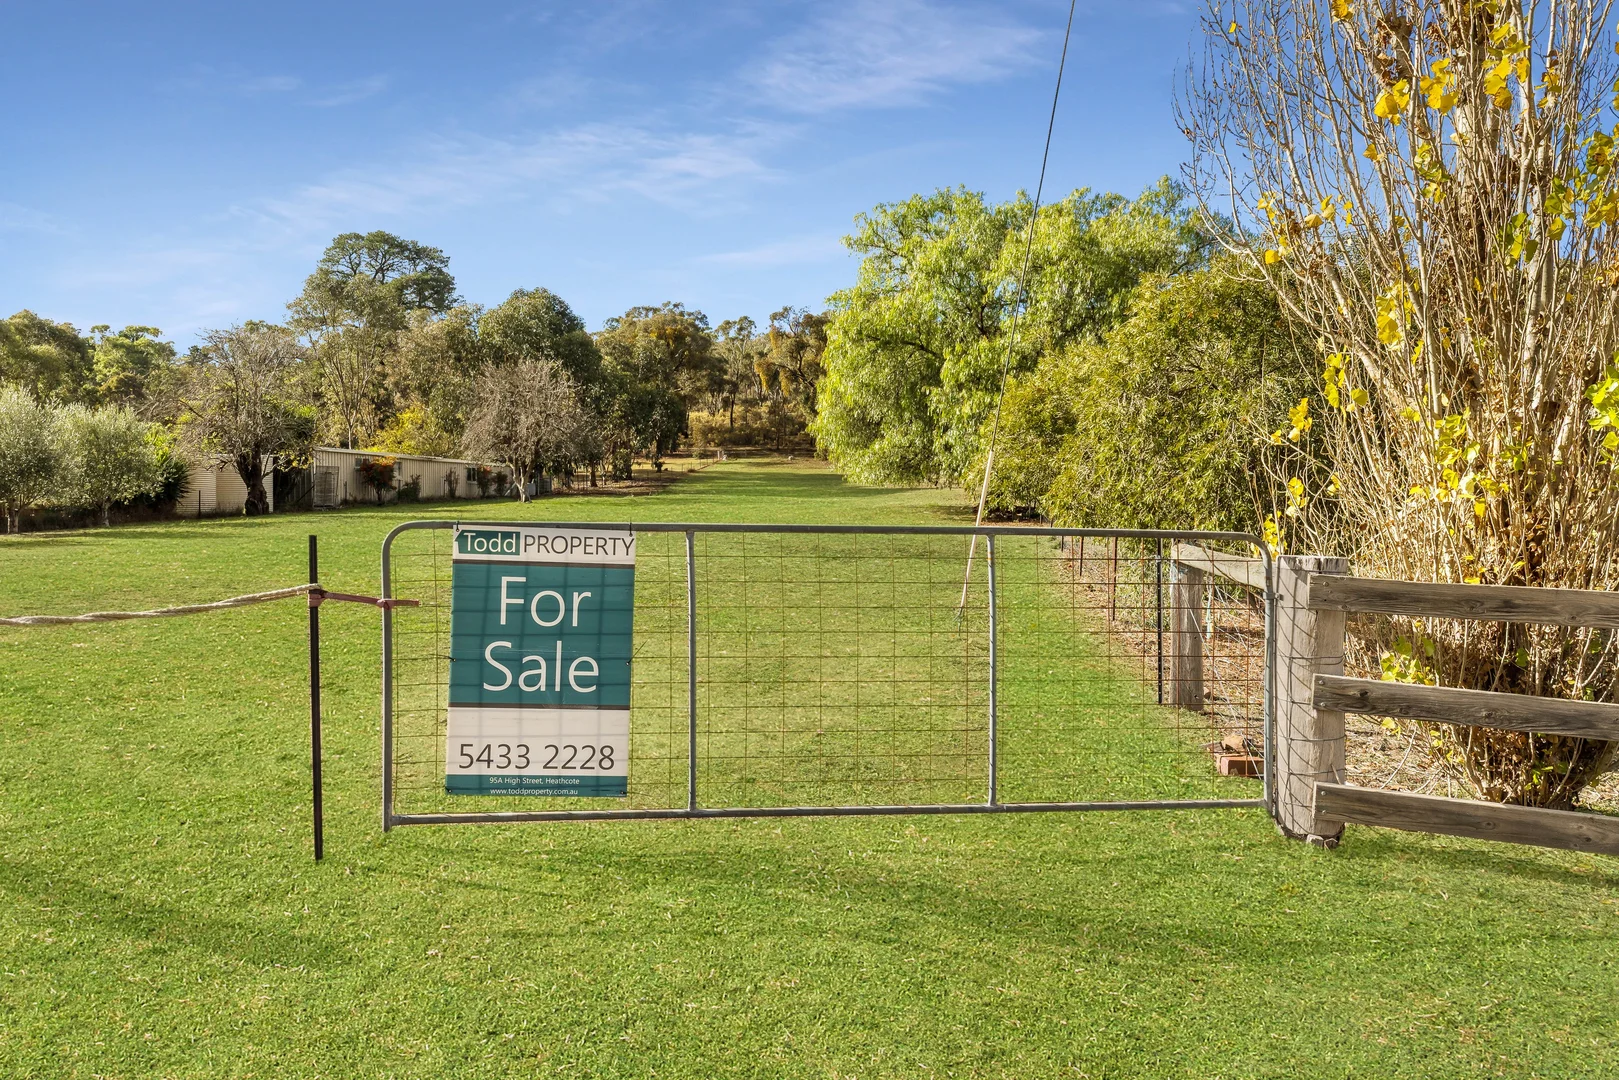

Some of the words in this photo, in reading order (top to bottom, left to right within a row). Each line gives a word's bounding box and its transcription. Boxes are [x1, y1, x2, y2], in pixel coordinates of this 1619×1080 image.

[463, 532, 517, 553] Todd
[523, 535, 635, 556] PROPERTY
[499, 576, 592, 627] For
[483, 640, 600, 693] Sale
[458, 743, 531, 770] 5433
[542, 744, 615, 771] 2228
[504, 777, 520, 786] High
